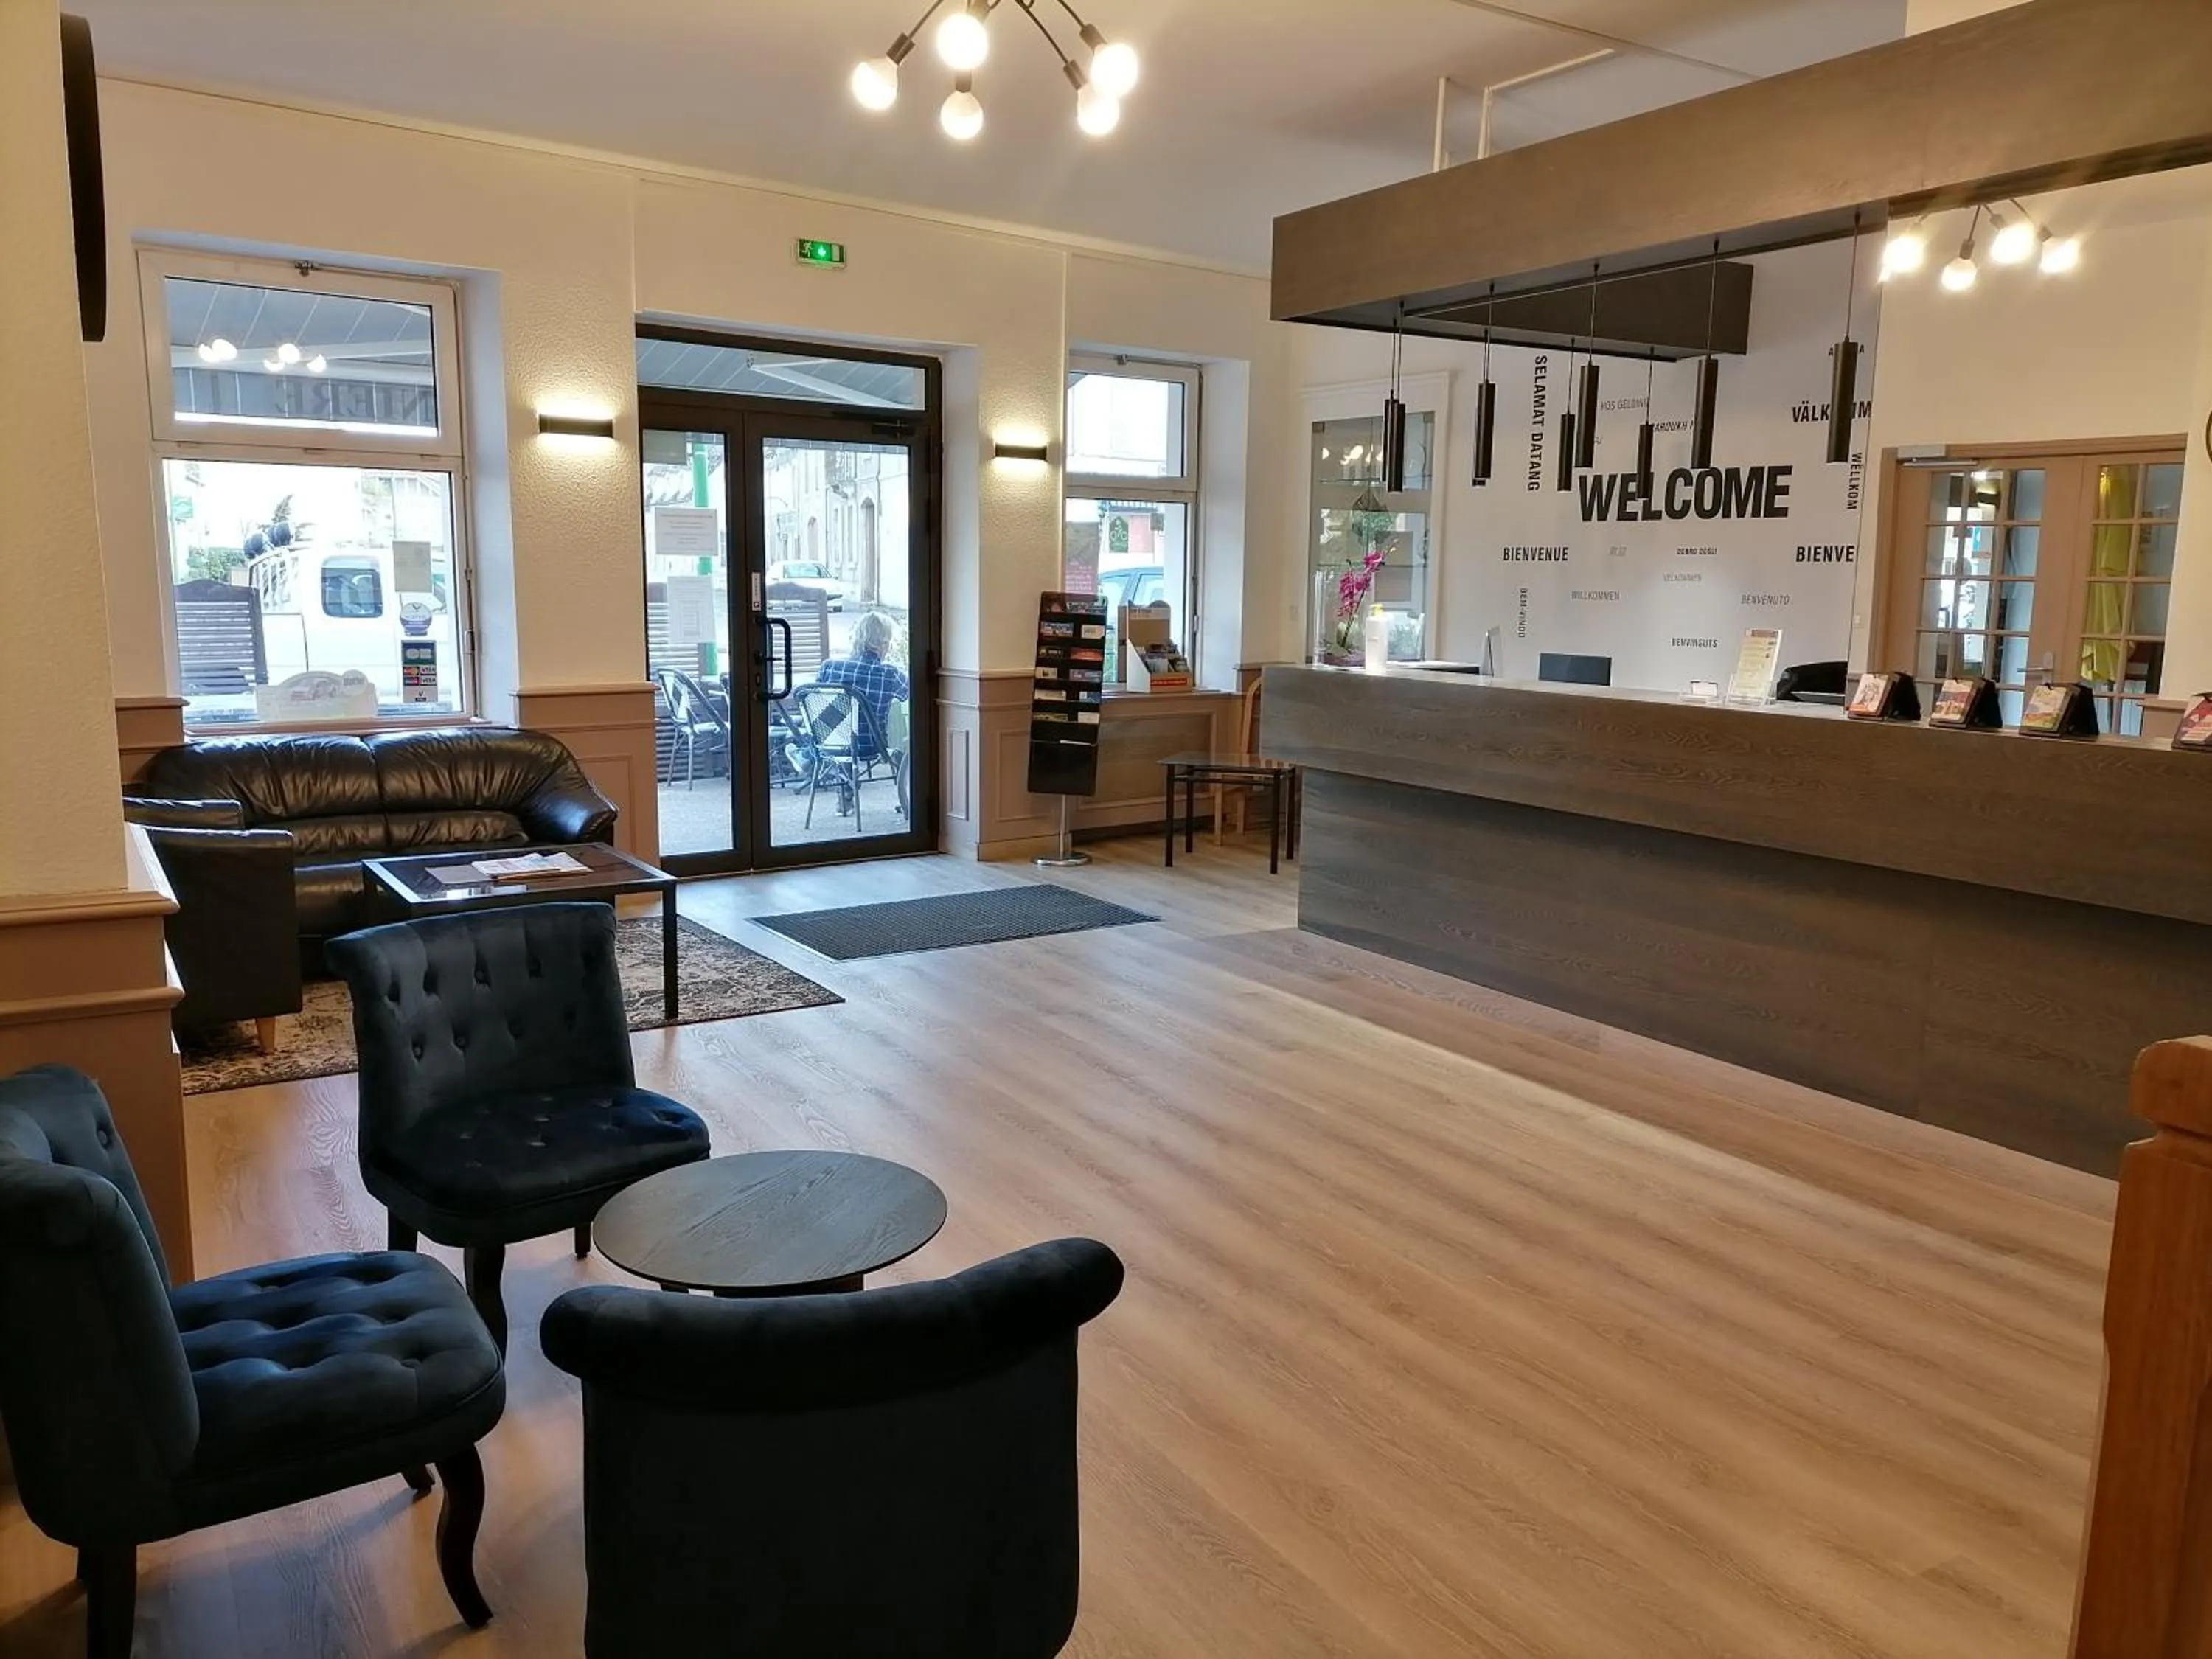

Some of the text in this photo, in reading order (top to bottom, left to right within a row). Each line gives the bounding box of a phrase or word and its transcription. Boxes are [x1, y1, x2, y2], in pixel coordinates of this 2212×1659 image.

[1527, 355, 1548, 492] SELAMAT DATANG
[1579, 466, 1792, 521] WELCOME
[1503, 547, 1569, 561] BIENVENUE
[1796, 545, 1855, 563] BIENVE
